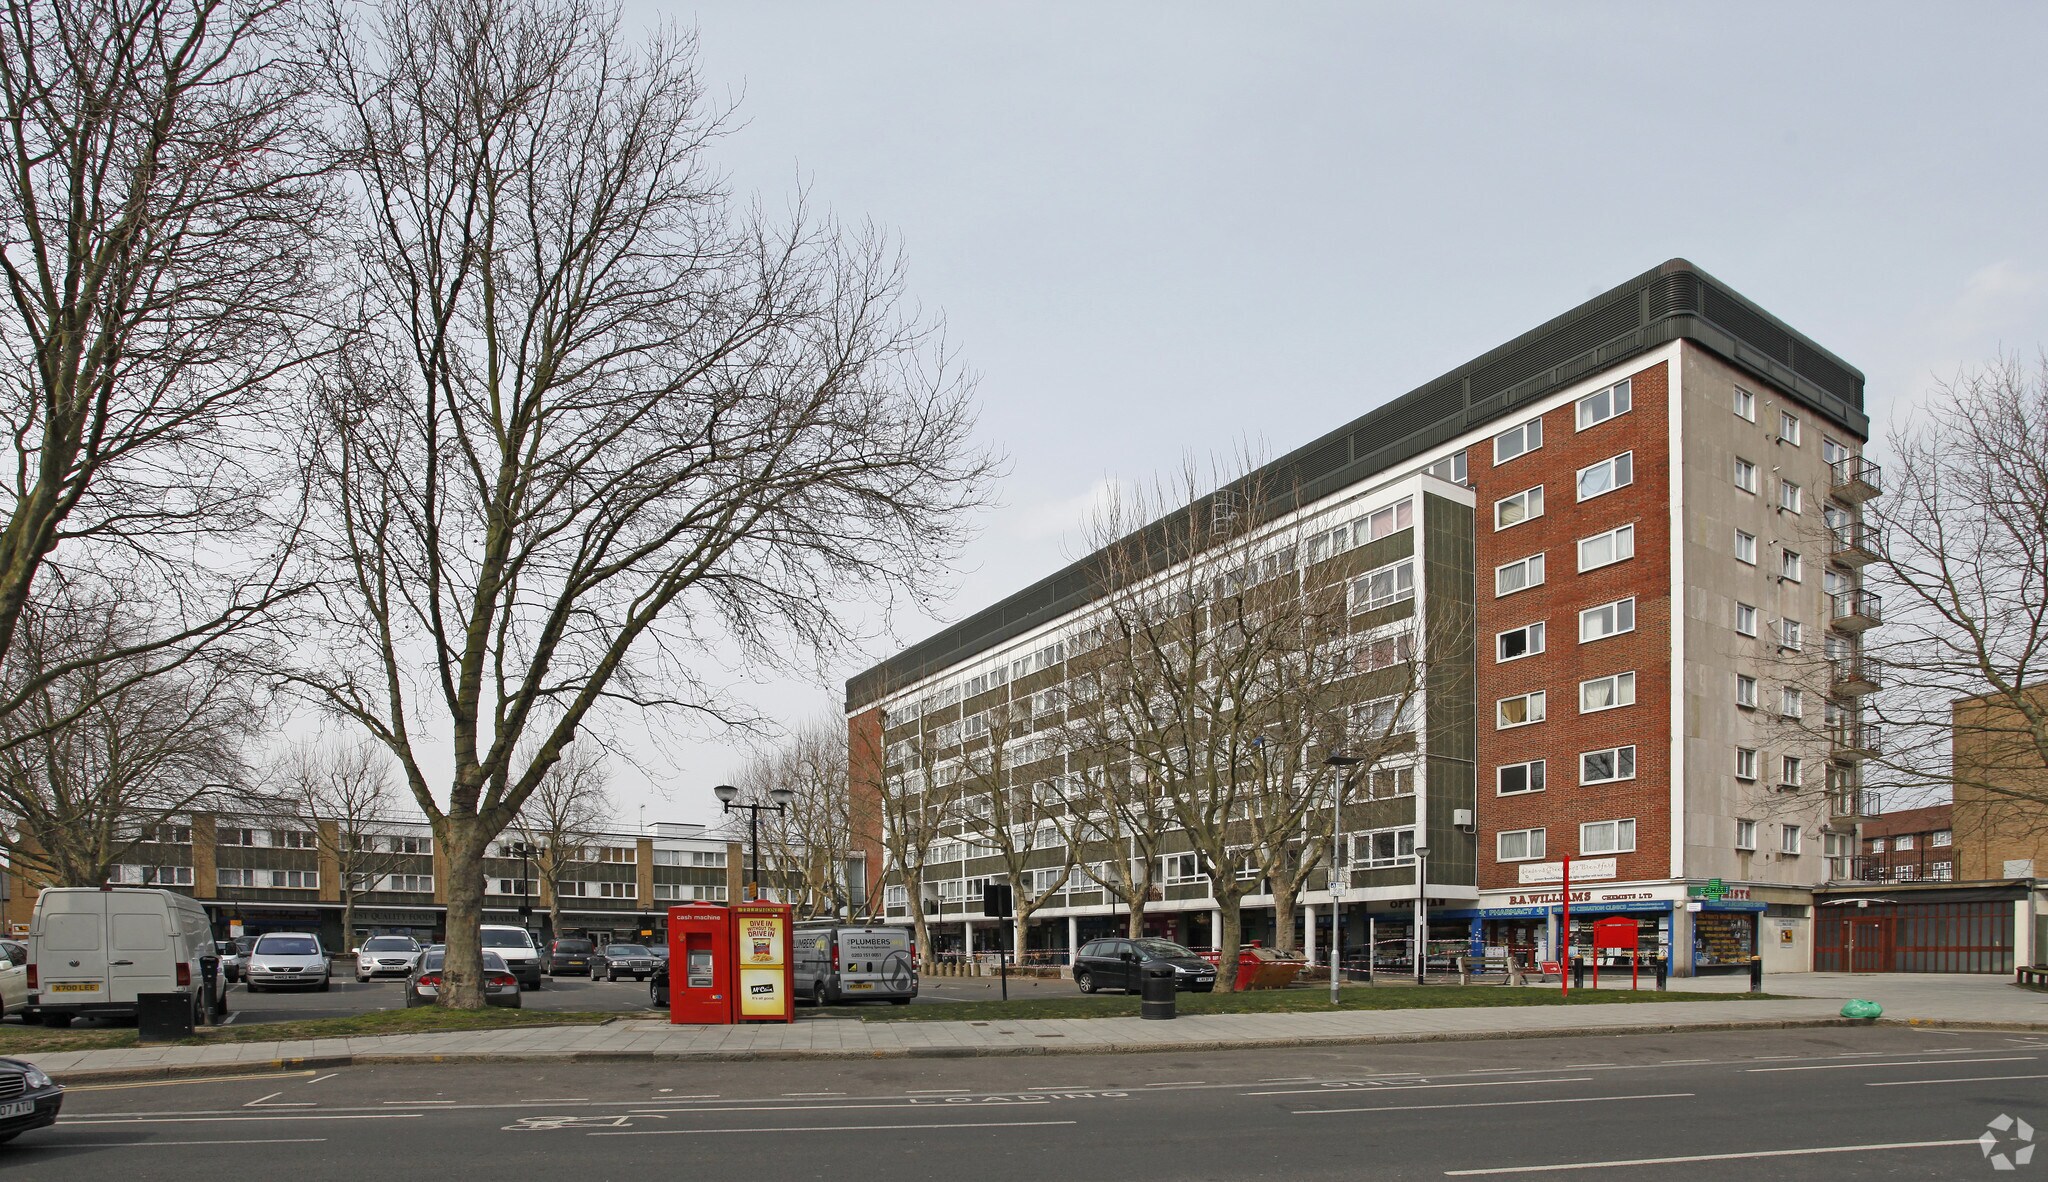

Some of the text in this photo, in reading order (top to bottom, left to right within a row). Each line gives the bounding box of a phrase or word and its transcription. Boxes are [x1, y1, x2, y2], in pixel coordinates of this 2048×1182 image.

[354, 912, 435, 921] EST QUALITY FOODS
[1489, 908, 1533, 916] PHARMACY
[850, 938, 891, 946] PLUMBERS
[909, 1079, 1431, 1105] LOADING ONLY
[0, 1101, 32, 1116] 07 ATU
